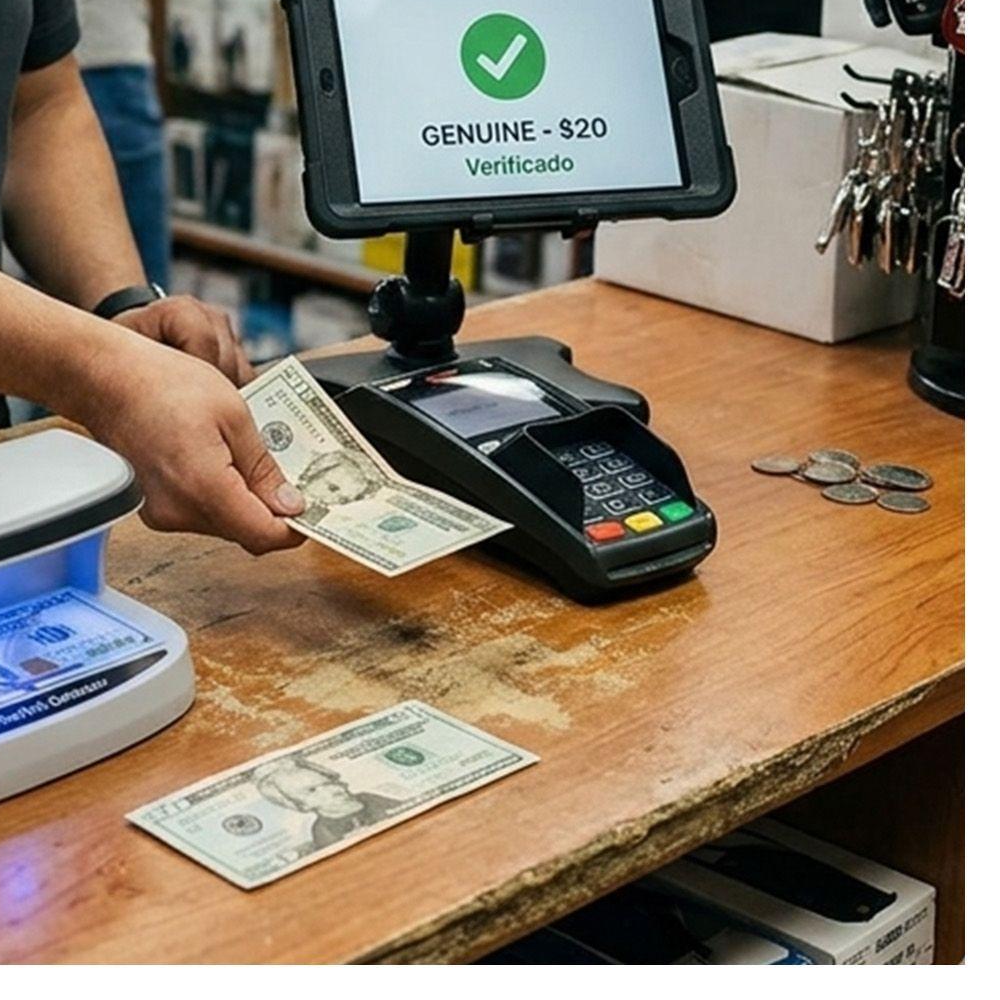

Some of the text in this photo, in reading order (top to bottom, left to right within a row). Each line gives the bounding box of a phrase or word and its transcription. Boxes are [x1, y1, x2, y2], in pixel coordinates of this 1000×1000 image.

[421, 120, 537, 146] GENUINE
[559, 117, 607, 140] $20
[465, 154, 574, 177] Verificado
